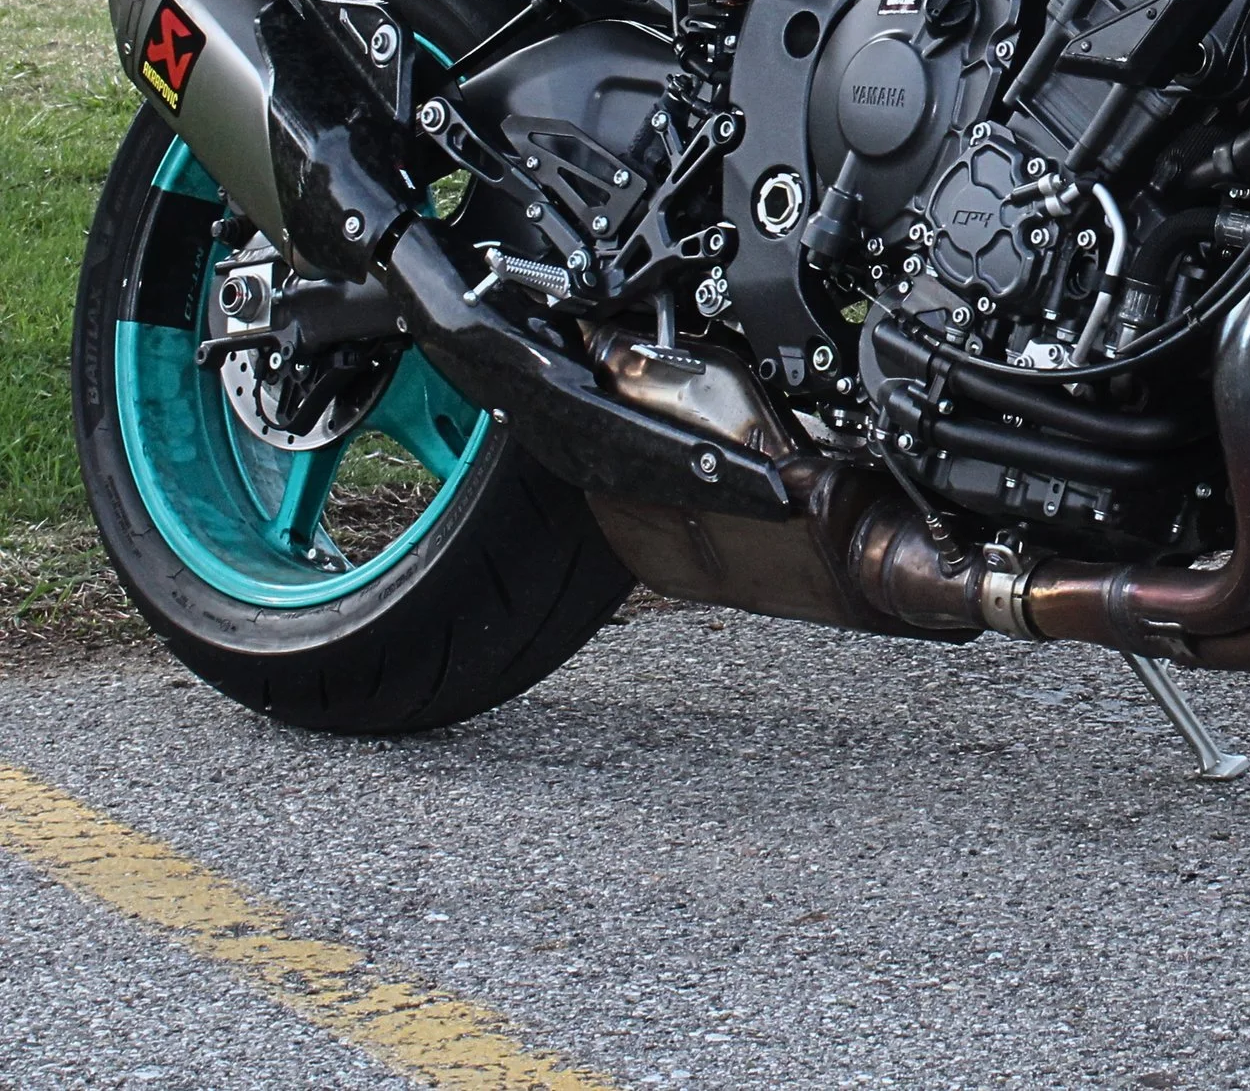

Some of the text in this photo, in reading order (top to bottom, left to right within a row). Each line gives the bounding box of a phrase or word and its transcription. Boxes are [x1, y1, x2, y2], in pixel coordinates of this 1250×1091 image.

[142, 60, 179, 110] AKRAPOVIC
[852, 85, 905, 108] YAMAHA
[952, 210, 994, 228] CP4
